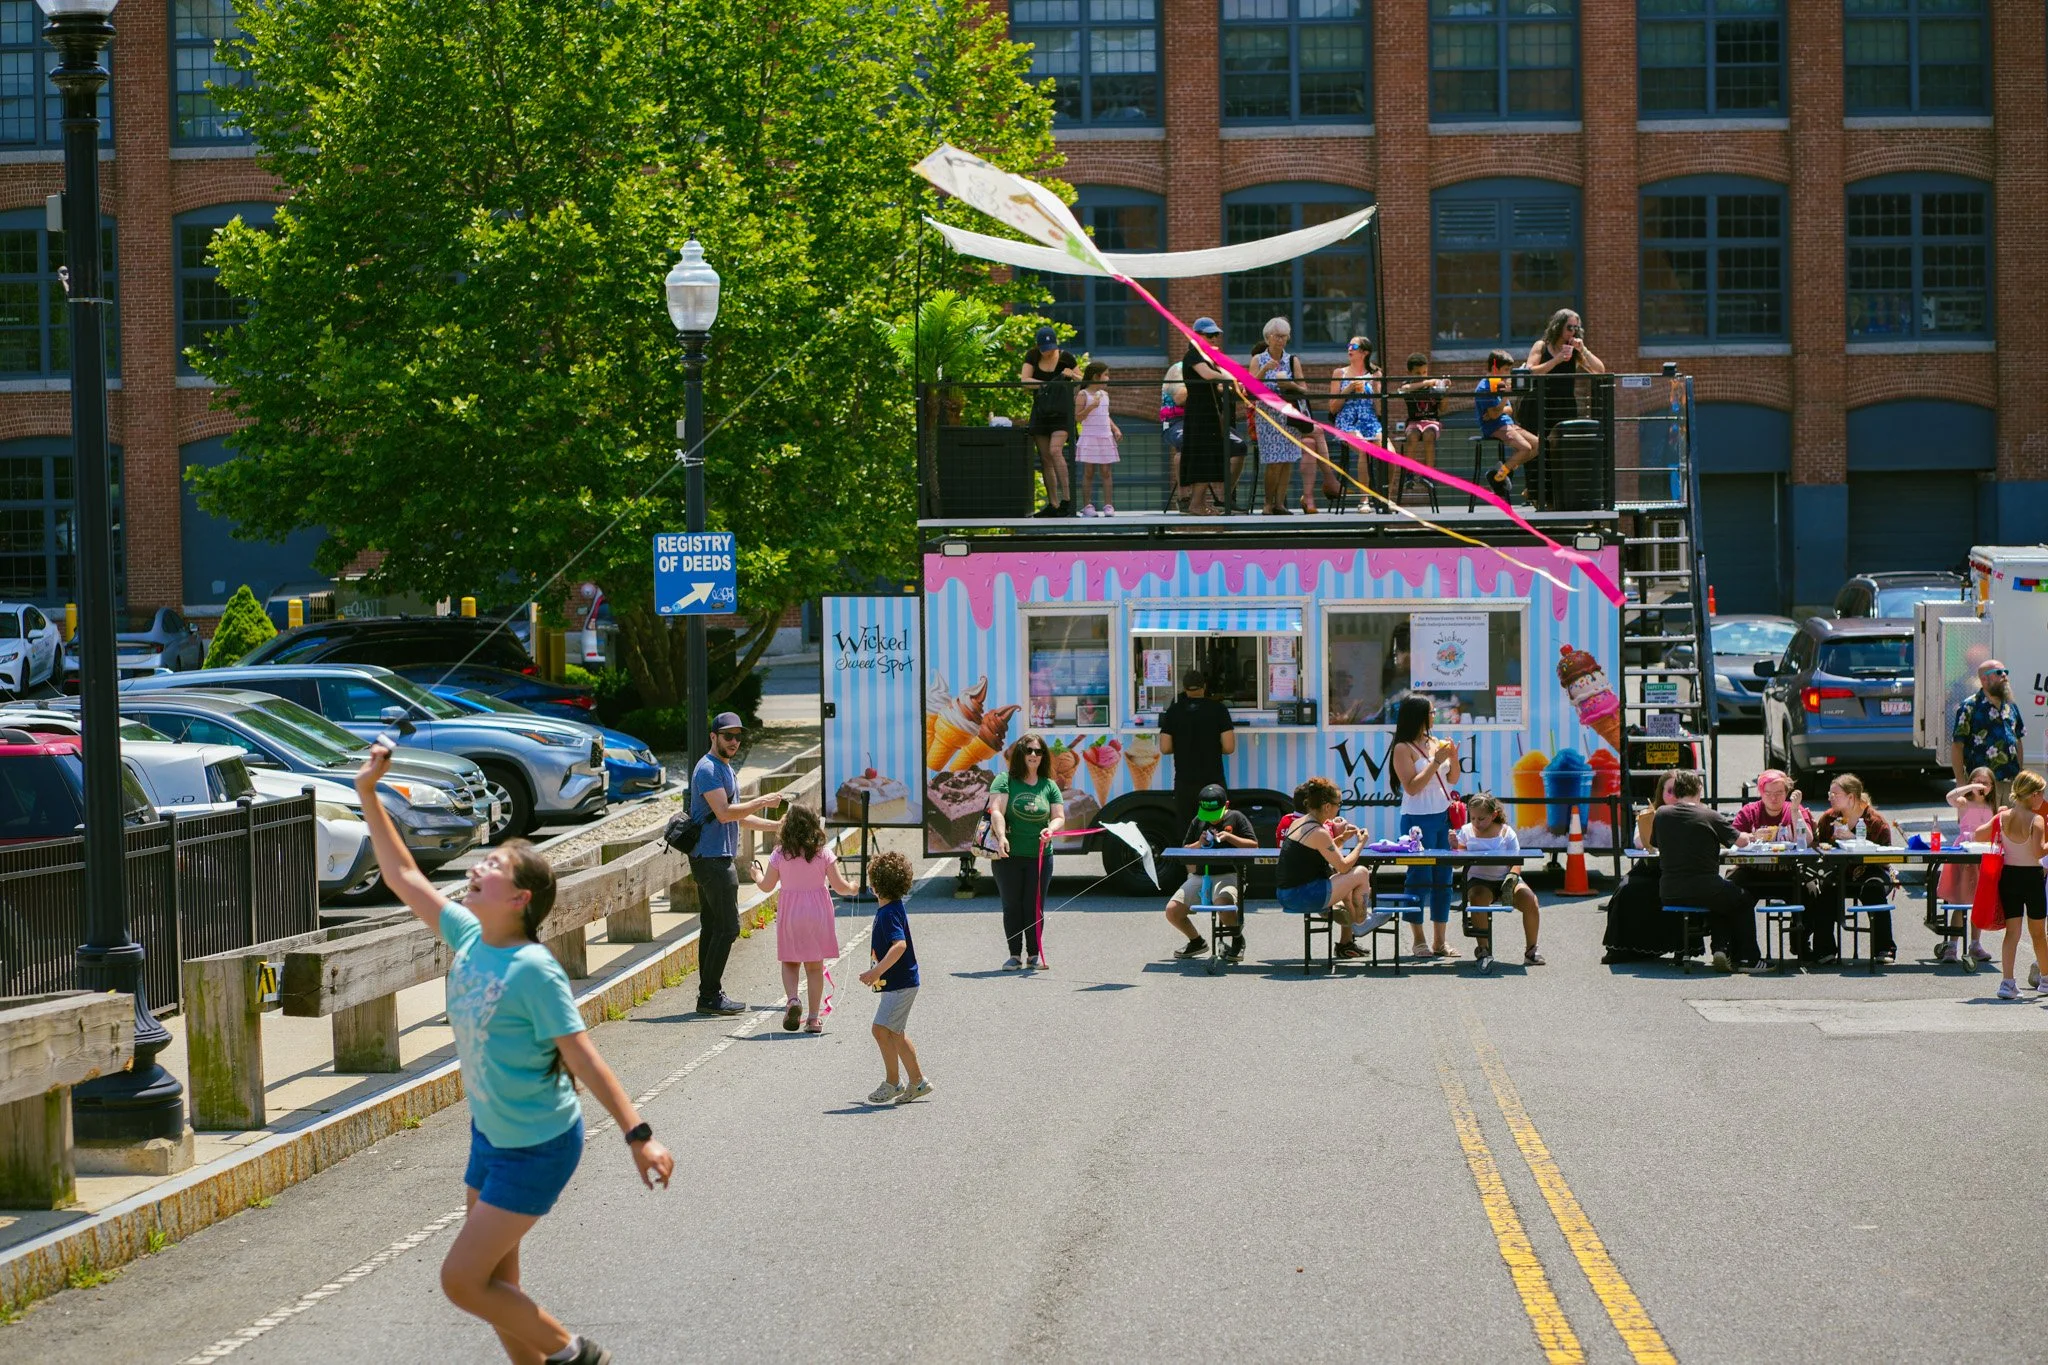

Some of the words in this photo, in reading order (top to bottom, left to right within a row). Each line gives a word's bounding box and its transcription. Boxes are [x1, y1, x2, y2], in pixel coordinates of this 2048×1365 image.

[657, 535, 731, 553] REGISTRY
[658, 556, 678, 572] OF
[682, 555, 731, 572] DEEDS
[832, 624, 909, 654] Wicked
[1433, 630, 1468, 645] Wicked
[835, 652, 875, 671] Sweet
[877, 655, 915, 679] Spot
